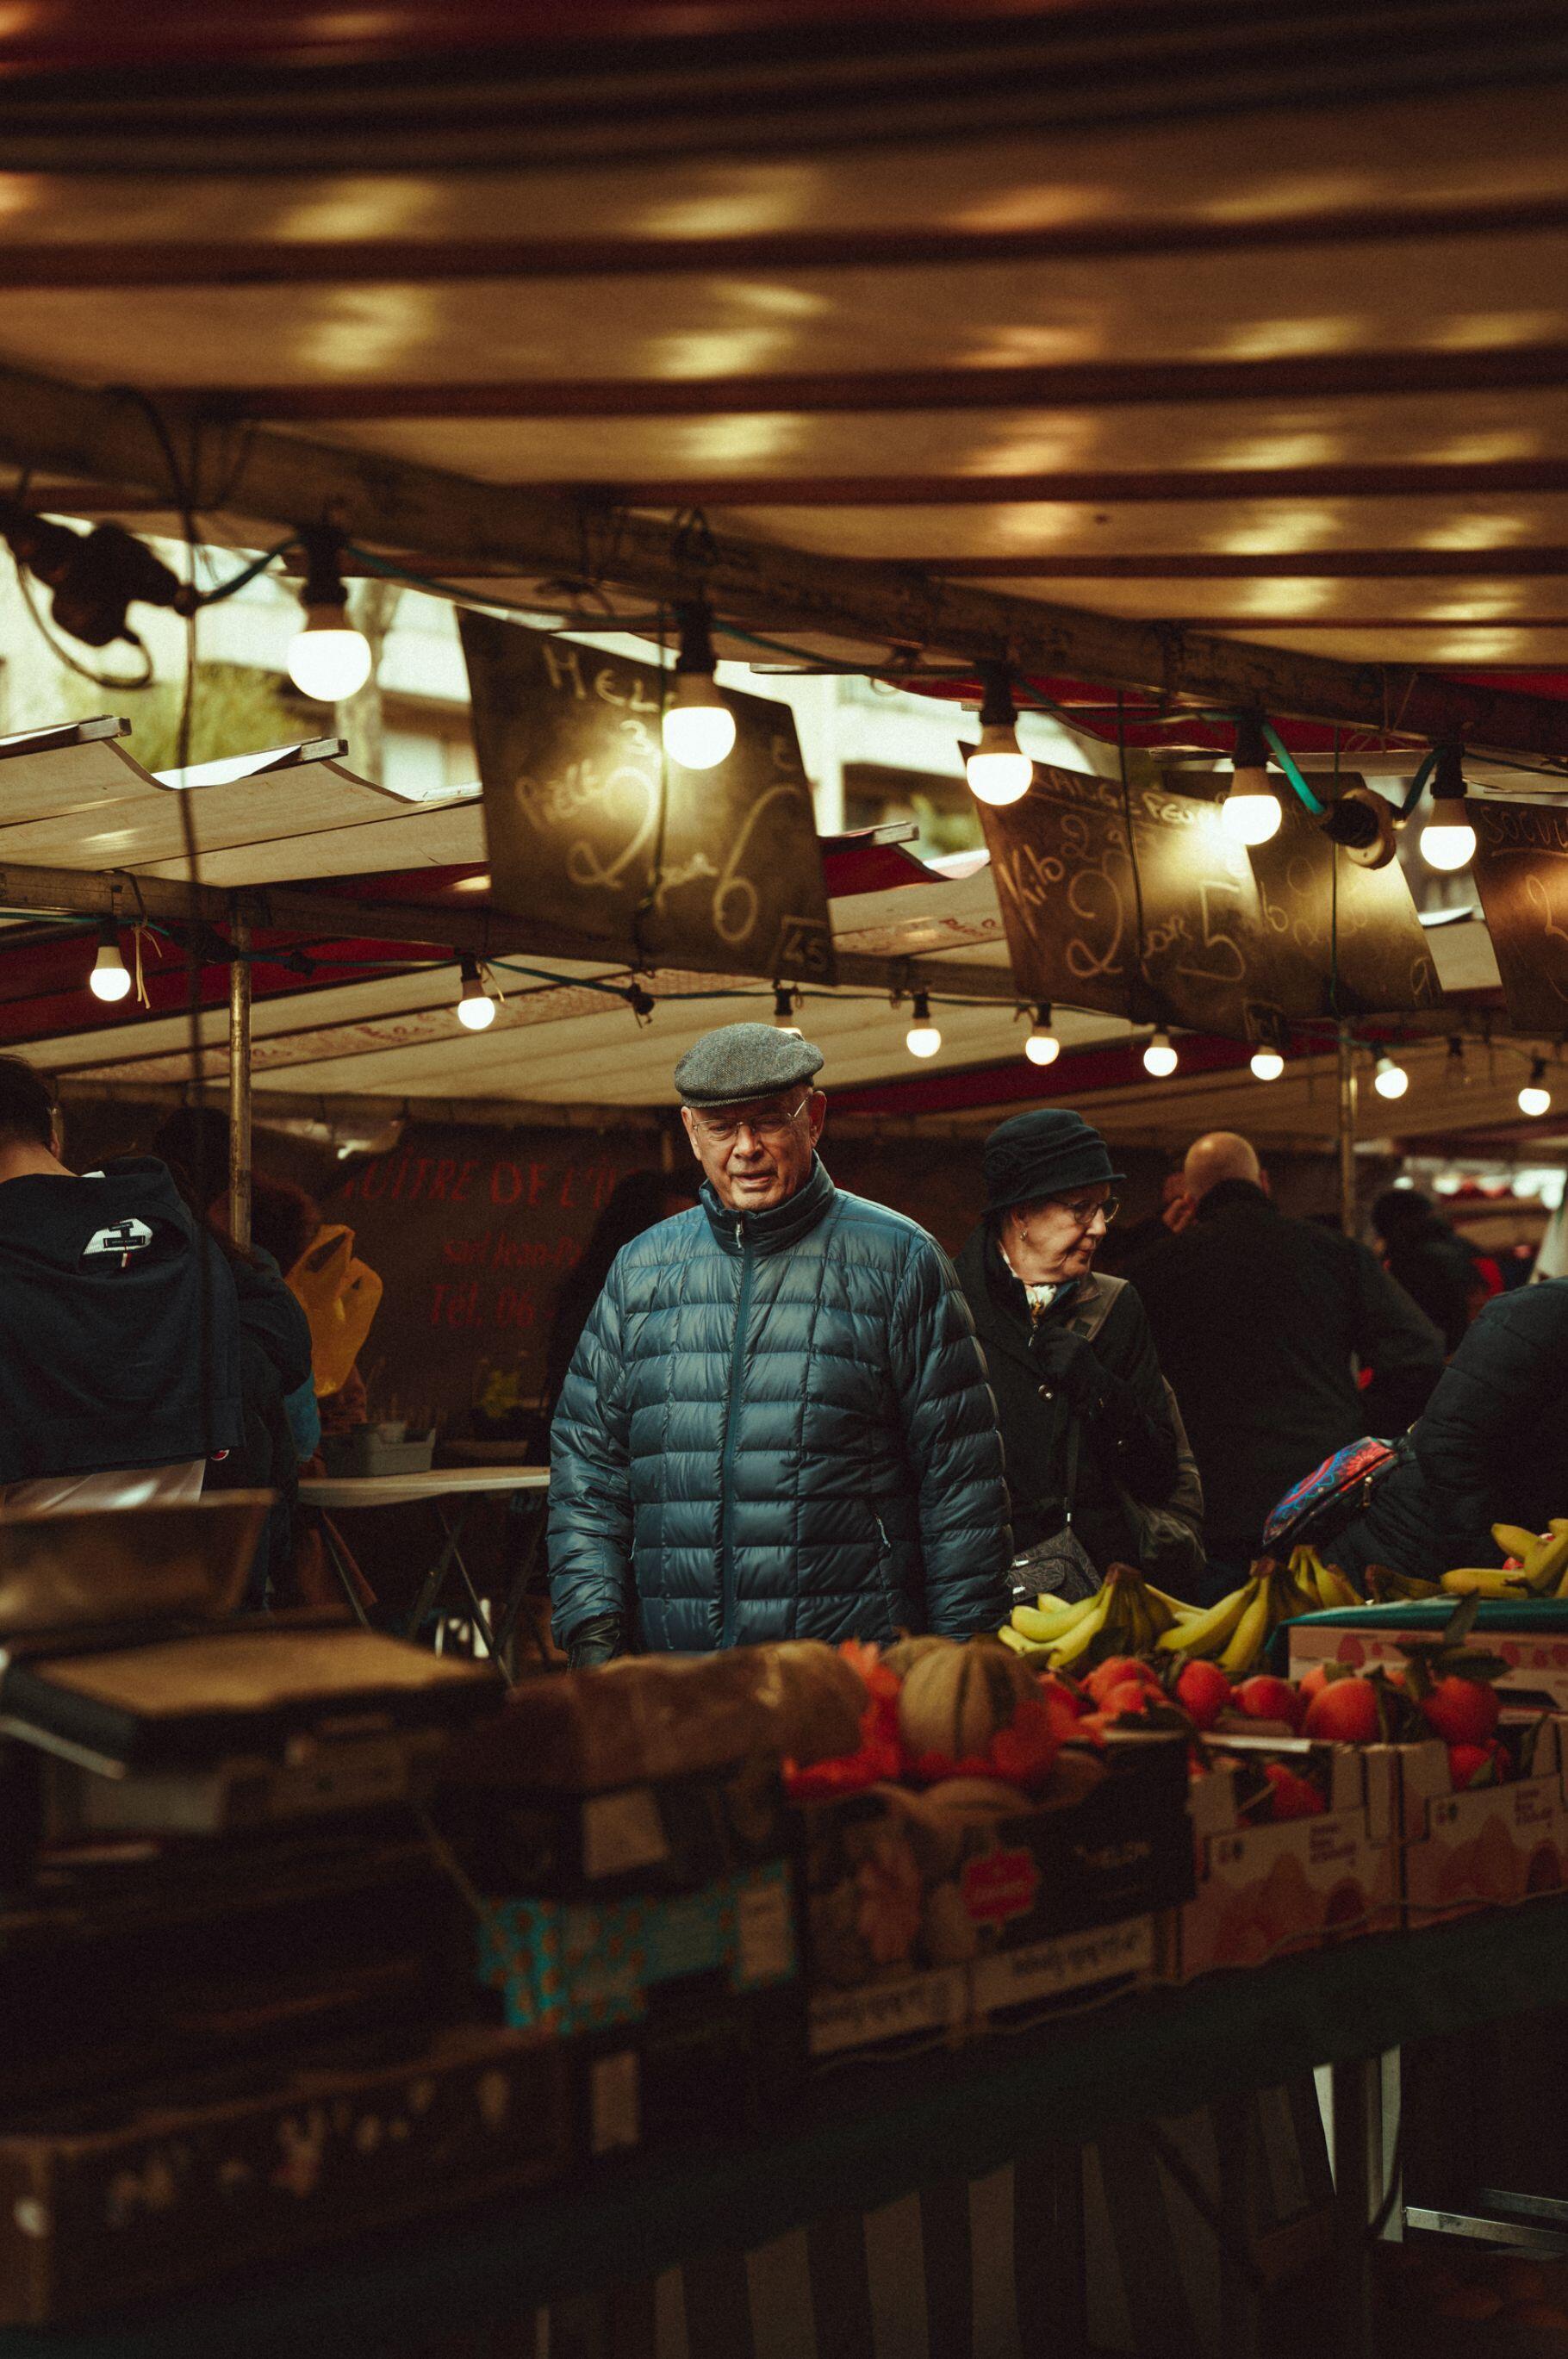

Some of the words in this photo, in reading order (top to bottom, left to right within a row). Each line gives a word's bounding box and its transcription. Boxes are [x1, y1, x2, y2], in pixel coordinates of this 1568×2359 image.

[568, 765, 657, 888] 2
[712, 780, 805, 942] 6
[1065, 868, 1123, 980] 2
